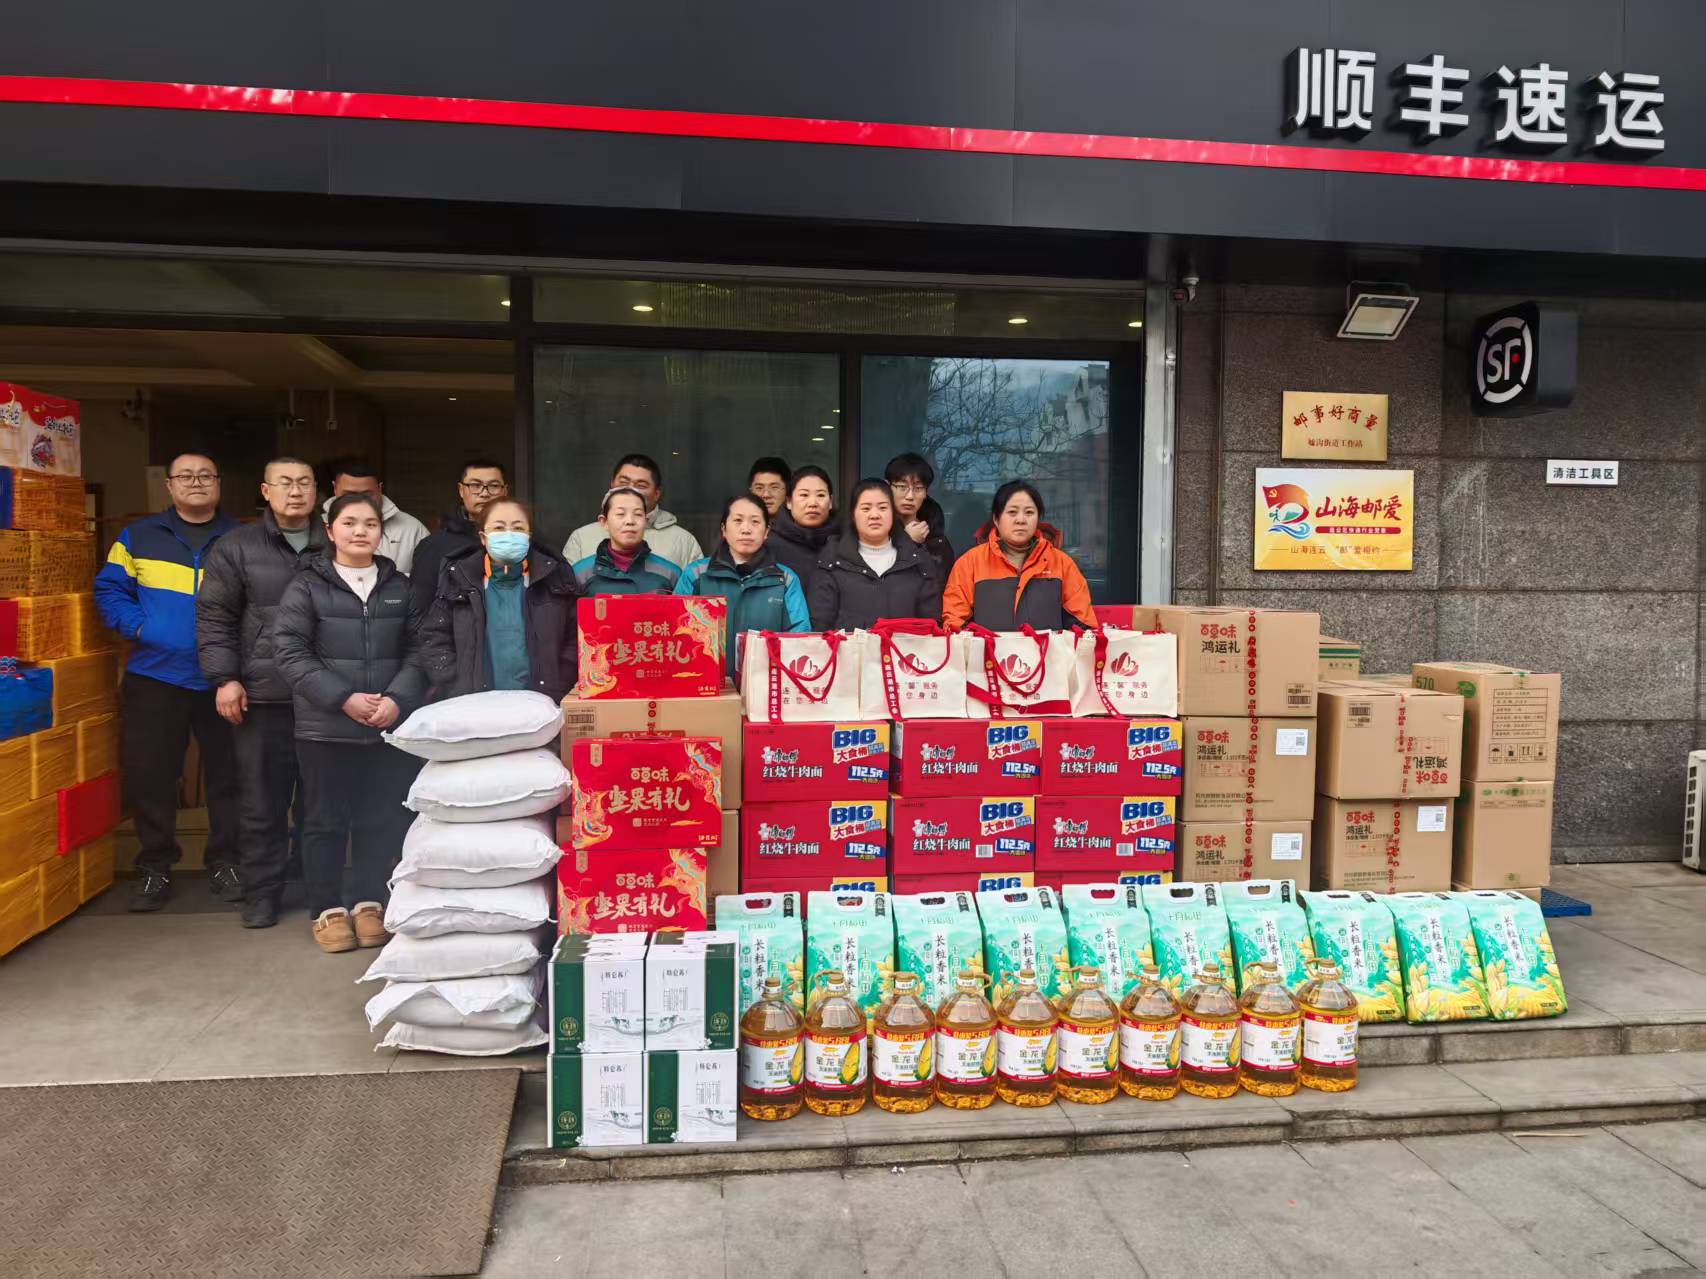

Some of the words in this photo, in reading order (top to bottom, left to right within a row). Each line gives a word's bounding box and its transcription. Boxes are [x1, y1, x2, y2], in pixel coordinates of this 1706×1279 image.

[1295, 47, 1665, 150] 顺丰速运
[1293, 404, 1379, 431] 邮事好商量
[1552, 466, 1615, 480] 清洁工具区
[1315, 495, 1402, 521] 山海邮爱
[633, 620, 671, 638] 百草味
[1200, 623, 1236, 639] 百草味
[613, 639, 690, 666] 坚果有礼
[1201, 640, 1240, 653] 鸿运礼
[833, 728, 877, 749] BIG
[988, 725, 1029, 745] BIG
[1128, 726, 1170, 746] BIG
[1197, 730, 1229, 744] 百草味
[836, 746, 868, 762] 大食桶
[991, 743, 1021, 758] 大食桶
[1131, 743, 1162, 757] 大食桶
[1197, 744, 1227, 755] 鸿运礼
[921, 761, 978, 774] 红烧牛肉面
[1005, 761, 1036, 774] 112.5克
[1060, 762, 1118, 774] 红烧牛肉面
[1146, 762, 1177, 774] 112.5克
[1413, 755, 1448, 769] 鸿运礼
[630, 766, 670, 783] 百草味
[762, 765, 823, 778] 红烧牛肉面
[851, 765, 883, 778] 112.5克
[1415, 770, 1448, 785] 百草味
[607, 785, 690, 814] 坚果有礼
[830, 805, 874, 826] BIG
[981, 801, 1023, 822] BIG
[1122, 801, 1164, 821] BIG
[1345, 810, 1375, 825] 百草味
[834, 823, 865, 839] 大食桶
[984, 819, 1015, 834] 大食桶
[1126, 818, 1156, 833] 大食桶
[1345, 825, 1373, 835] 鸿运礼
[759, 842, 820, 855] 红烧牛肉面
[848, 842, 881, 855] 112.5克
[912, 838, 971, 851] 红烧牛肉面
[999, 838, 1031, 850] 112.5克
[1053, 836, 1112, 848] 红烧牛肉面
[1140, 837, 1171, 849] 112.5克
[1195, 834, 1226, 849] 百草味
[1195, 850, 1225, 860] 鸿运礼
[615, 872, 655, 889] 百草味
[593, 891, 676, 920] 坚果有礼
[1350, 920, 1364, 969] 长粒香米
[1430, 918, 1446, 965] 长粒香米
[1504, 915, 1524, 963] 长粒香米
[1022, 932, 1035, 970] 长粒香
[1105, 927, 1120, 977] 长粒香米
[935, 935, 948, 986] 长粒香米
